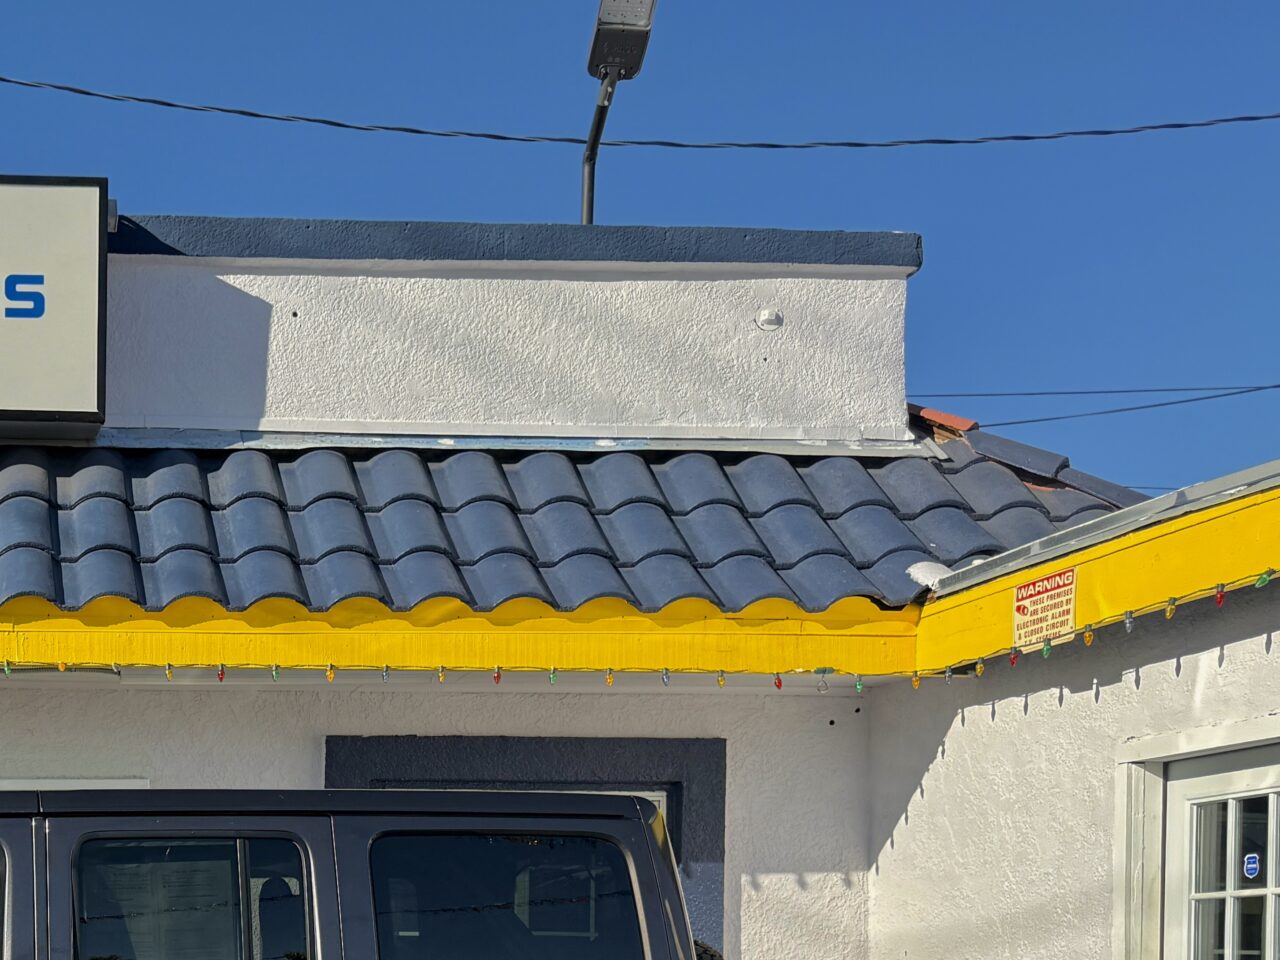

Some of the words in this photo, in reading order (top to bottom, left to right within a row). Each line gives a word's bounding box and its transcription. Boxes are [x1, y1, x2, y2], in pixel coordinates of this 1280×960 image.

[1018, 572, 1073, 599] WARNING
[1030, 596, 1045, 607] THESE
[1047, 588, 1073, 600] PREMISES
[1030, 608, 1039, 617] ARE
[1040, 600, 1064, 614] SECURED
[1065, 598, 1072, 606] BY
[1016, 615, 1049, 631] ELECTRONIC
[1051, 608, 1071, 620] ALARM
[1024, 626, 1044, 639] CLOSED
[1045, 618, 1070, 631] CIRCUIT
